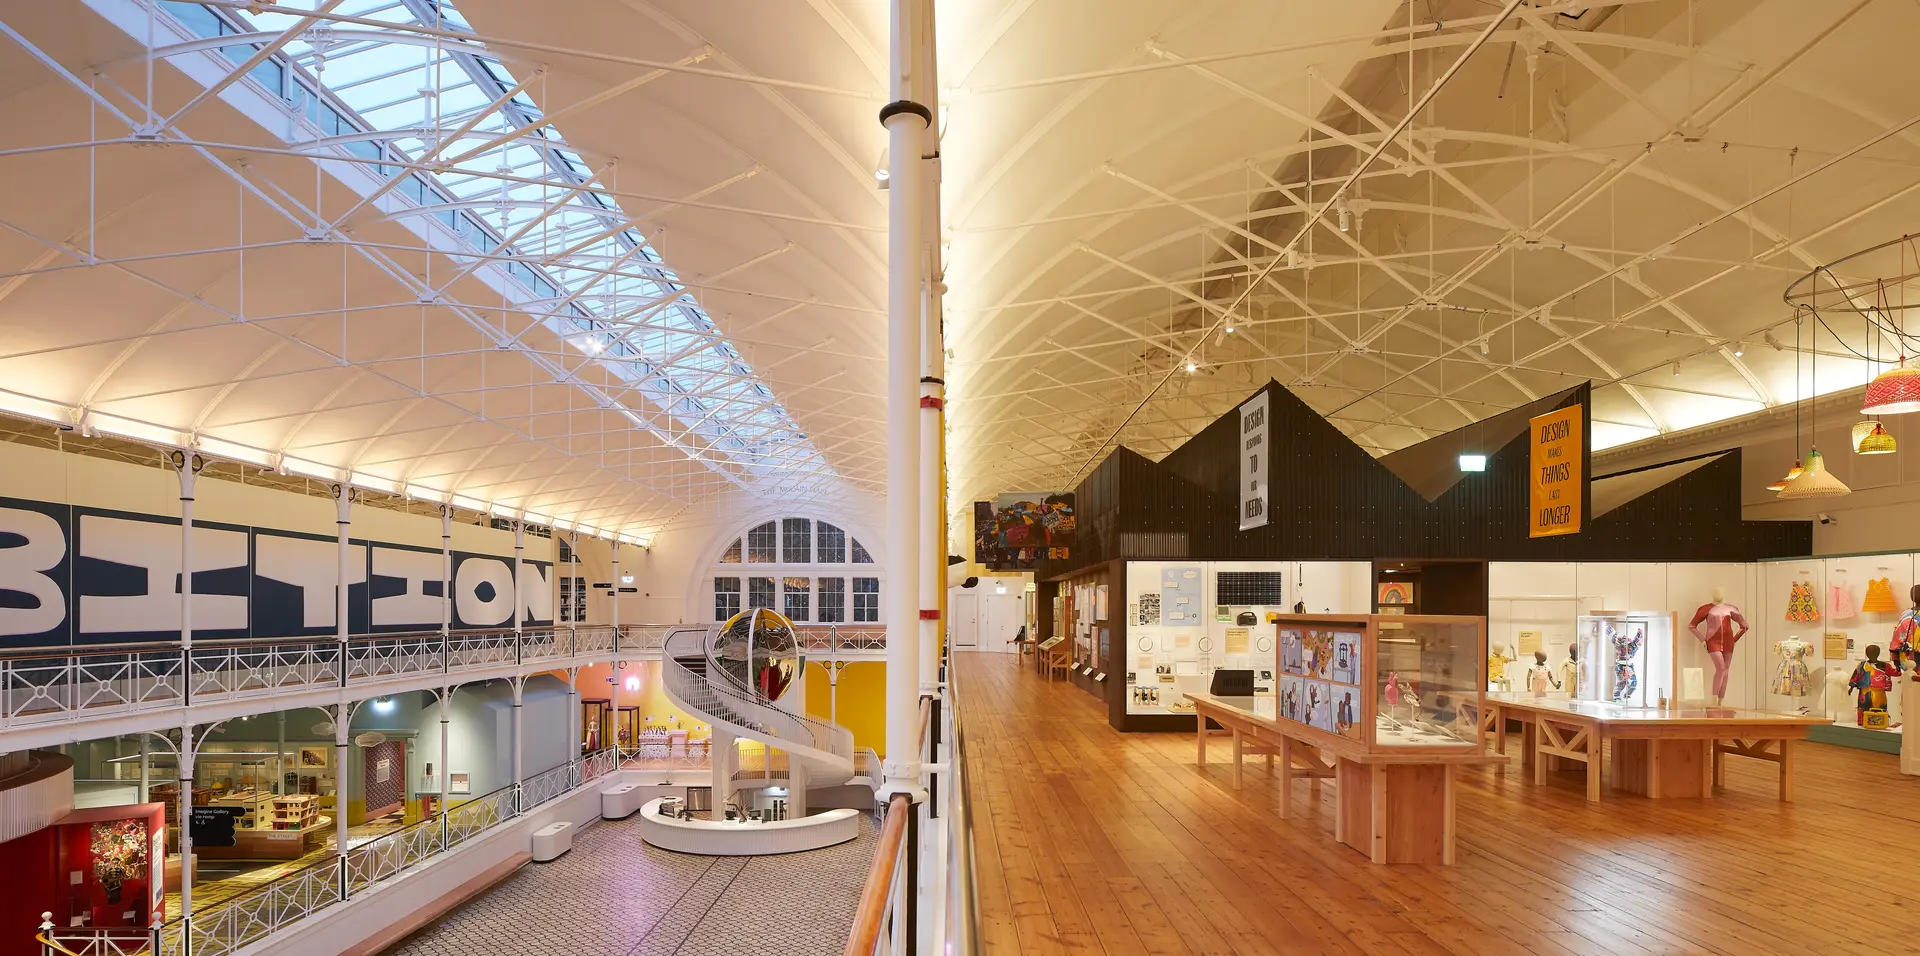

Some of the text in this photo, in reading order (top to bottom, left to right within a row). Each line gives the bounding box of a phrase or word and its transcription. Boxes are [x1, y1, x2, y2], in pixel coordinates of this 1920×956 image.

[1244, 406, 1264, 434] DESIGN
[1541, 419, 1570, 443] DESIGN
[1547, 446, 1562, 458] MAKES
[1250, 454, 1258, 474] TO
[1541, 462, 1571, 485] THINGS
[1548, 489, 1561, 500] LAST
[1245, 497, 1262, 519] NEEDS
[1539, 505, 1571, 526] LONGER
